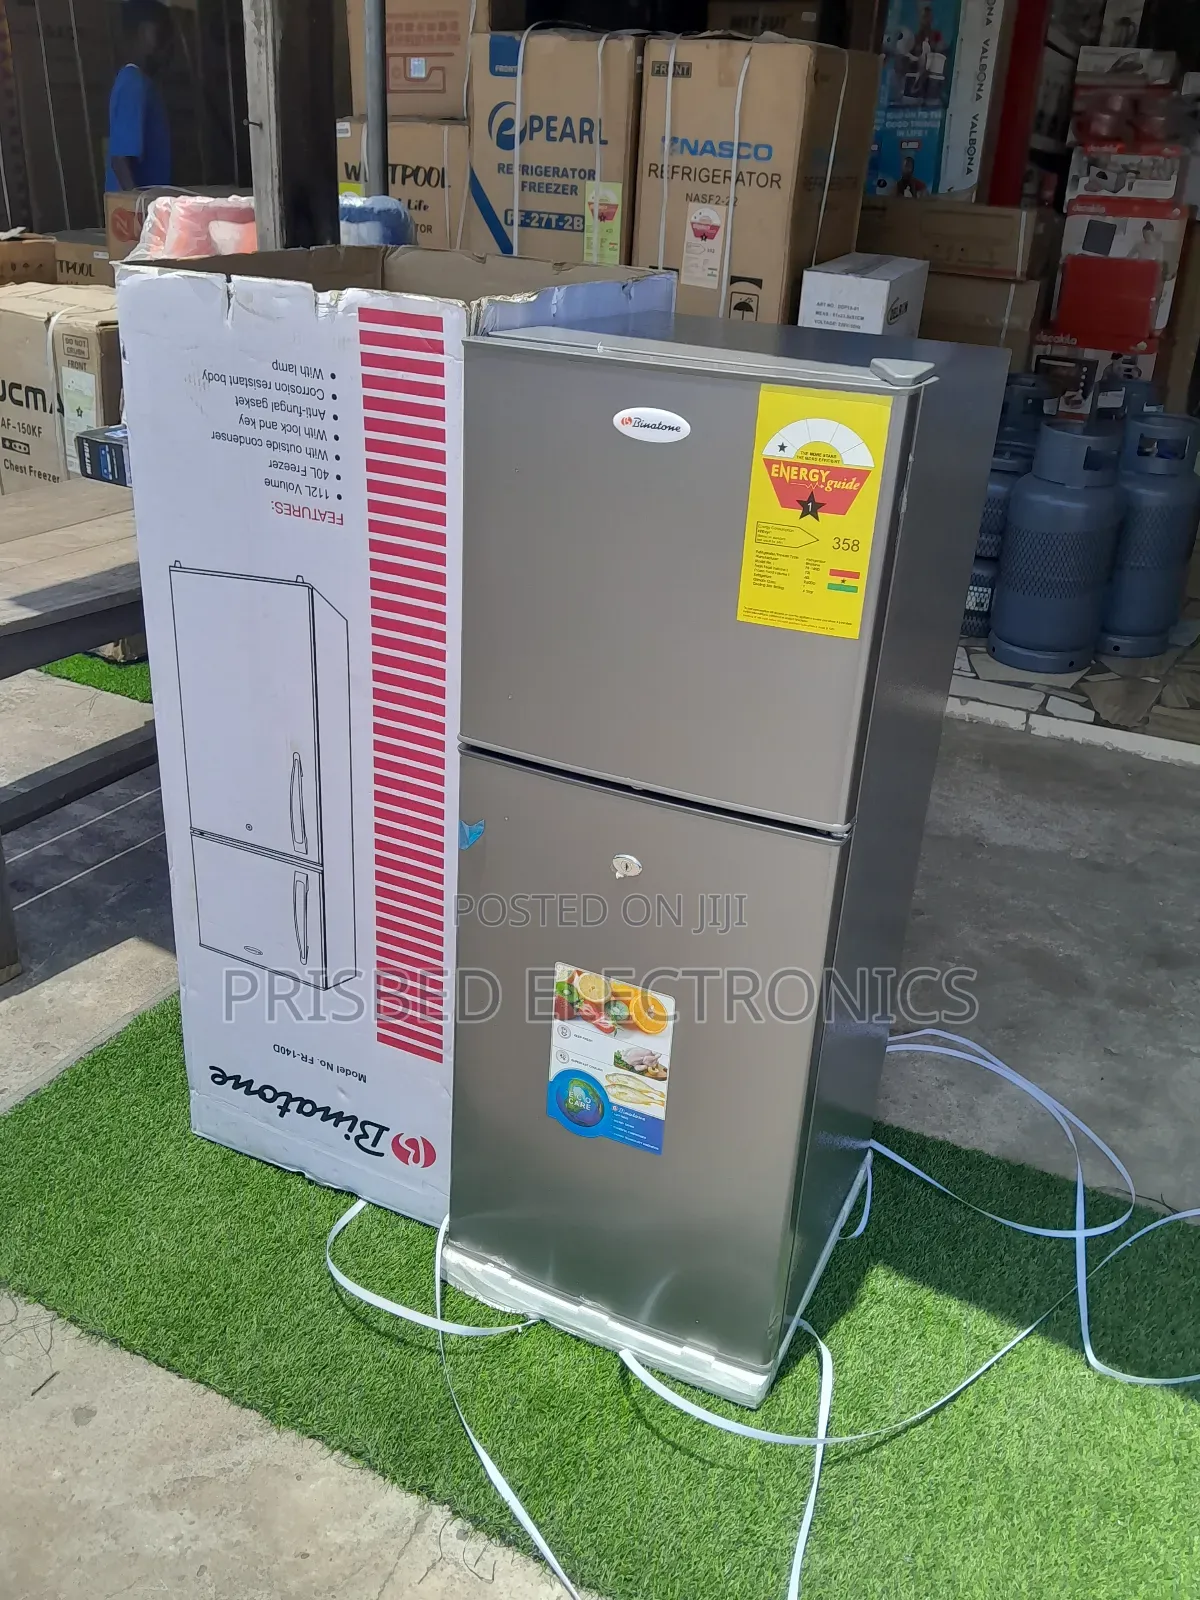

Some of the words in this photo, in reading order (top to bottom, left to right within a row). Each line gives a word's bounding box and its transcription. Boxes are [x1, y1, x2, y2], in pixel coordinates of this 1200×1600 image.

[654, 63, 690, 76] FRNT
[975, 38, 991, 102] VALBONA
[529, 115, 608, 145] PEARL
[680, 137, 773, 161] NASCO
[966, 113, 980, 175] VALBONA
[344, 162, 451, 189] WTPOOL
[497, 162, 596, 181] RERIGERATOR
[648, 163, 782, 189] REFRIGERATOR
[521, 181, 578, 196] FREEZER
[75, 339, 87, 348] NOT
[67, 359, 87, 372] FRONT
[271, 359, 297, 376] lamp
[300, 365, 324, 381] With
[202, 369, 227, 386] body
[229, 374, 272, 391] resistant
[274, 380, 325, 401] Corrosion
[235, 395, 268, 410] gasket
[271, 401, 326, 421] Anti-fungal
[238, 413, 257, 430] key
[259, 418, 278, 431] and
[281, 421, 302, 436] lock
[631, 416, 682, 433] Binatone
[211, 430, 263, 447] condenser
[303, 426, 328, 442] With
[266, 439, 303, 454] outside
[305, 446, 329, 462] With
[3, 458, 28, 476] Chest
[28, 465, 60, 485] Freezer
[268, 459, 307, 477] Freezer
[310, 466, 330, 481] 40L
[771, 461, 831, 483] ENERGY
[264, 477, 303, 496] Volume
[304, 485, 329, 500] 112L
[825, 476, 861, 492] guide
[270, 500, 344, 526] FEATURES:
[807, 502, 812, 512] 1
[831, 536, 860, 552] 358
[273, 1043, 314, 1065] FR-140D
[318, 1057, 334, 1072] No.
[336, 1066, 367, 1084] Model
[568, 1091, 592, 1105] ECO
[568, 1098, 591, 1112] CARE
[208, 1065, 391, 1157] Binatone
